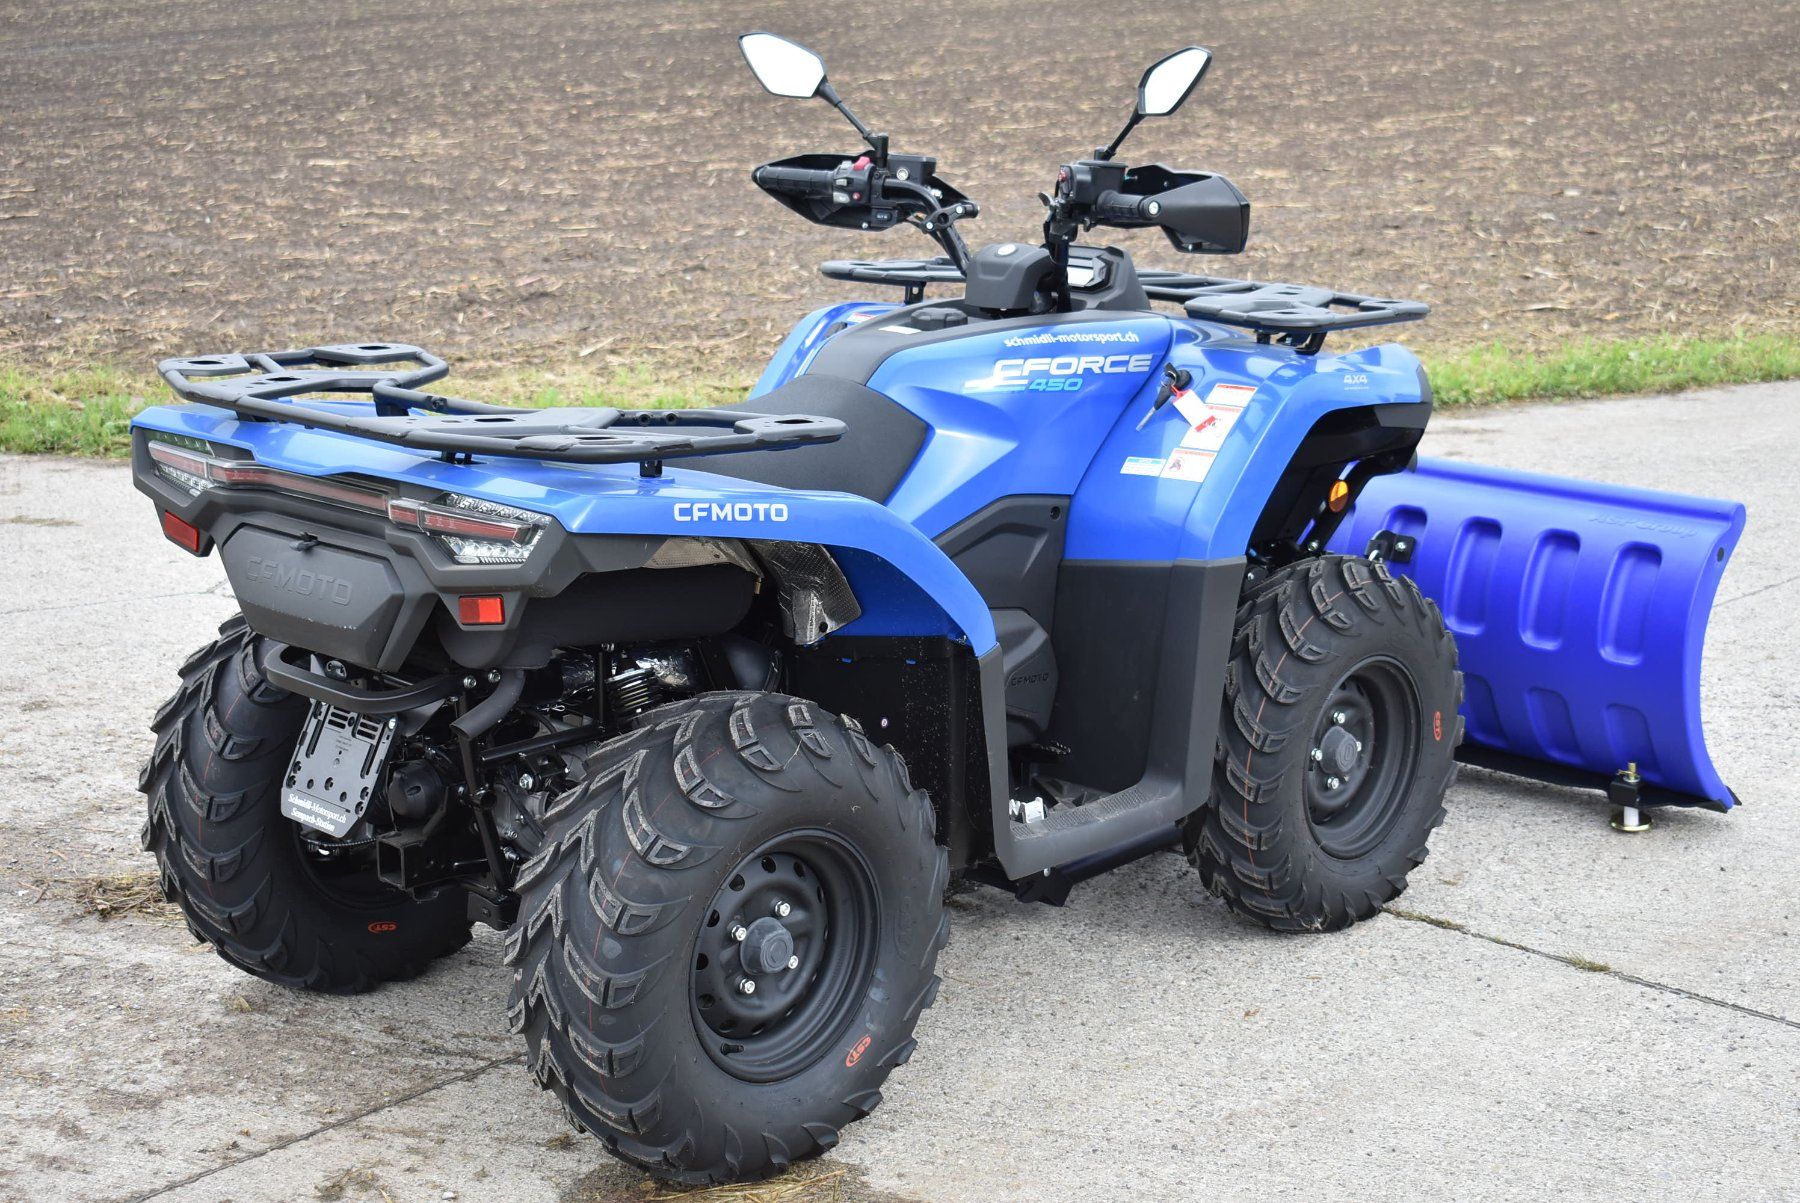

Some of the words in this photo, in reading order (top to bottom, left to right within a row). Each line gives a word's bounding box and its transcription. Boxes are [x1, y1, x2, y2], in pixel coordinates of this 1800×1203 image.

[1003, 331, 1140, 348] schmidli-motorsport.ch
[1028, 378, 1083, 392] 450
[673, 502, 789, 522] CFMOTO
[246, 556, 353, 606] CFMOTO
